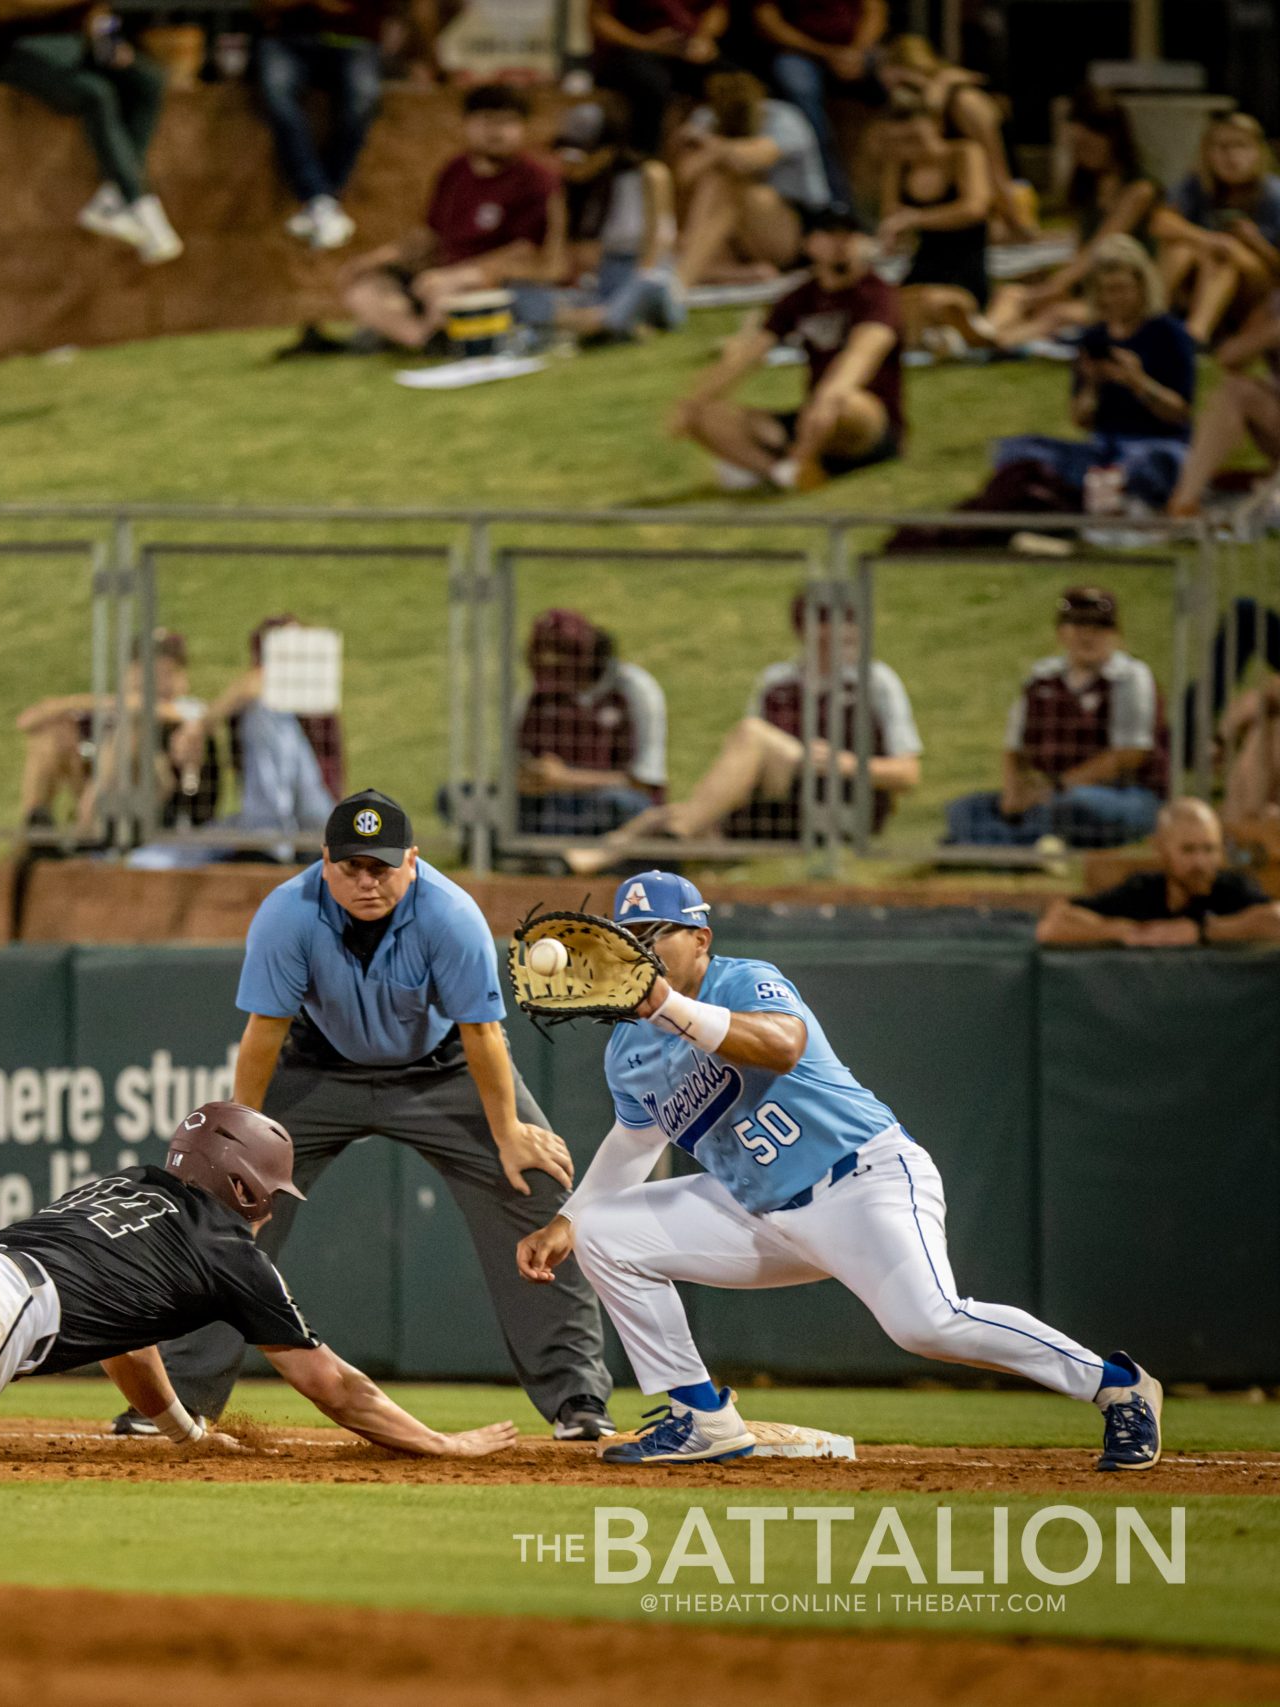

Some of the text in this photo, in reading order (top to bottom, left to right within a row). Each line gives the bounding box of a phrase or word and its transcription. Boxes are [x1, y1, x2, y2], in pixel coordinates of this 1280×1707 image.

[356, 811, 379, 834] SEC
[619, 882, 654, 915] A
[642, 1048, 727, 1138] Mavericks
[732, 1101, 802, 1166] 50
[38, 1176, 179, 1239] 14
